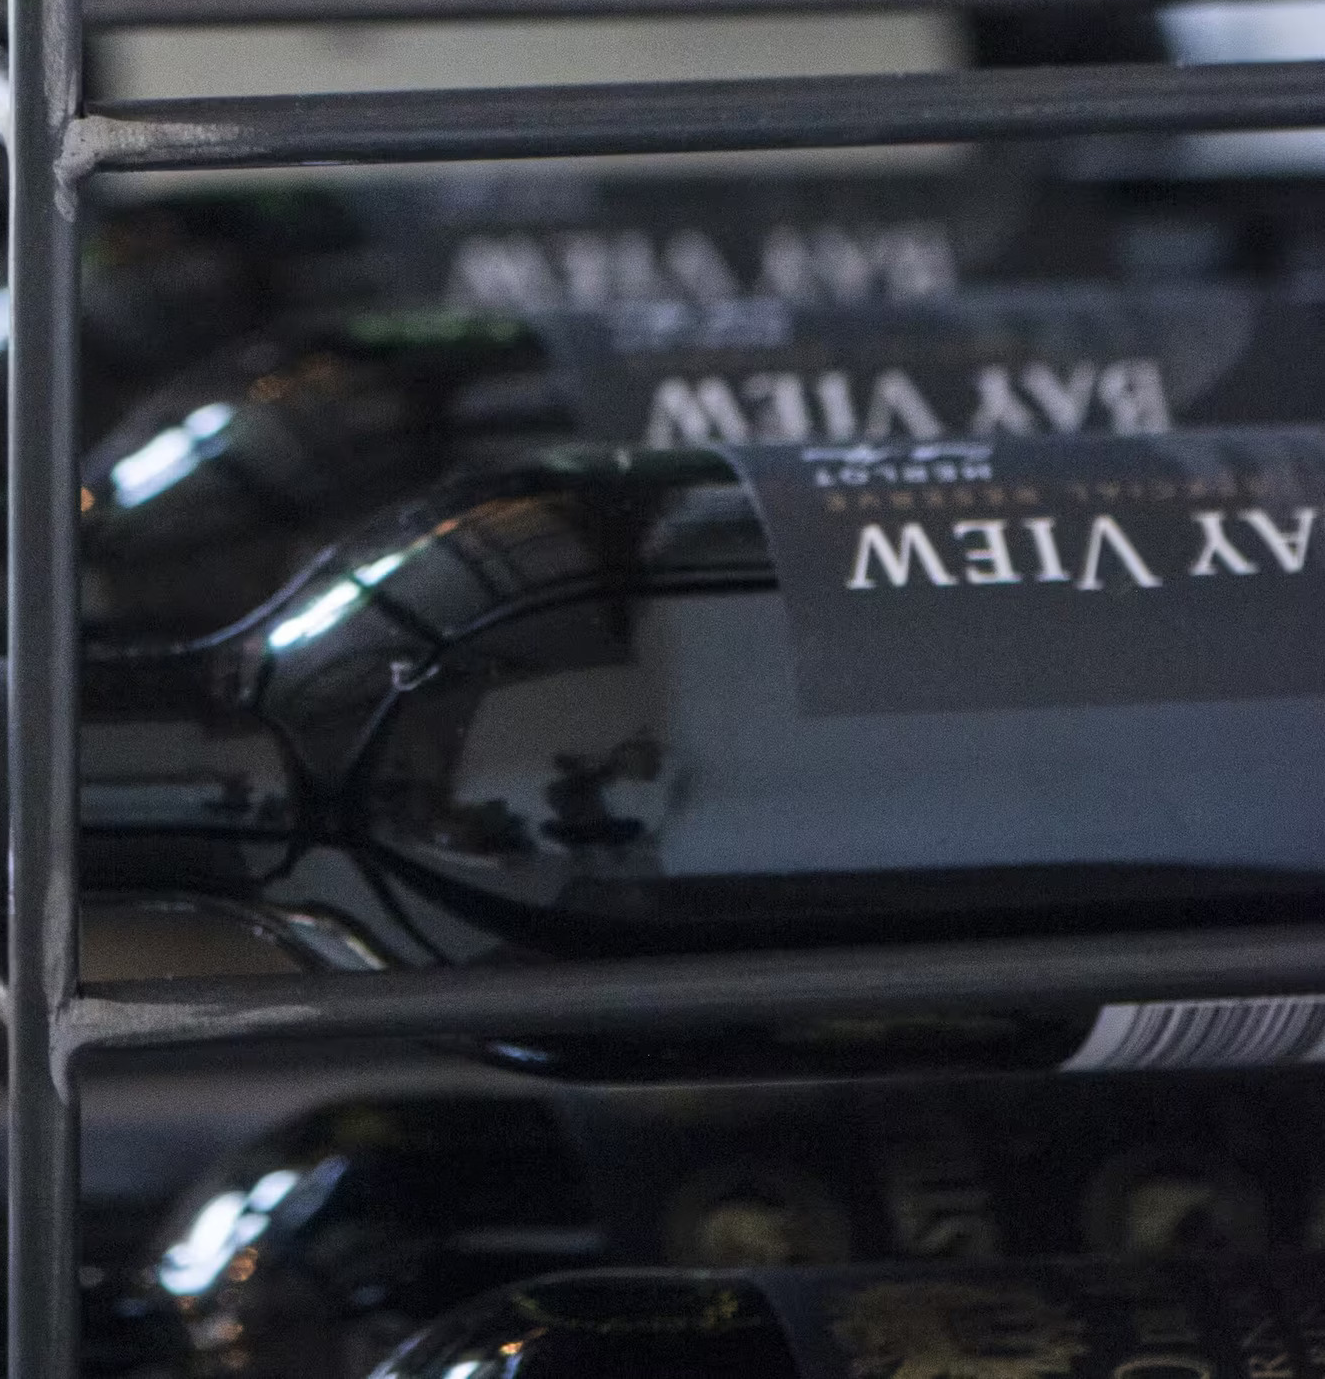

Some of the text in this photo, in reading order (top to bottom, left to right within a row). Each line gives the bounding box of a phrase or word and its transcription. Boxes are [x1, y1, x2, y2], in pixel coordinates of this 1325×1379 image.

[646, 357, 1172, 449] BAY VIEW
[814, 462, 993, 489] MERLOT
[846, 515, 1165, 591] VIEW
